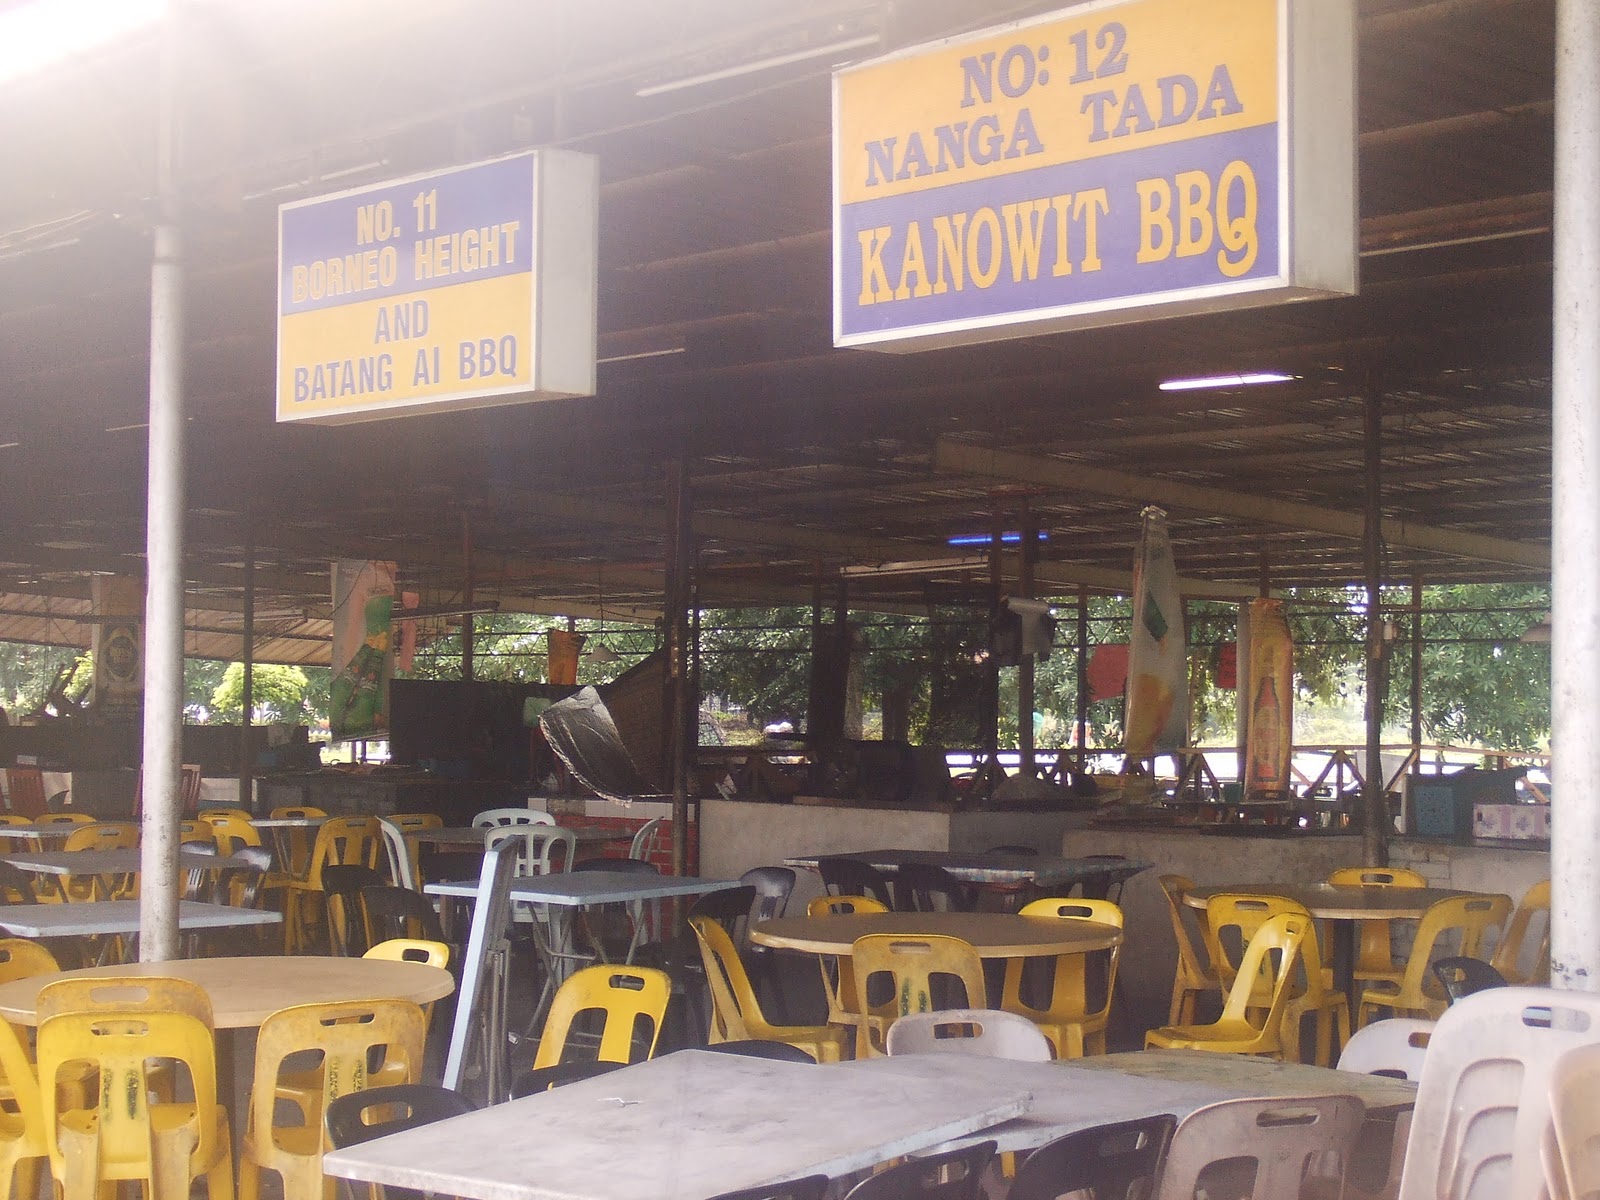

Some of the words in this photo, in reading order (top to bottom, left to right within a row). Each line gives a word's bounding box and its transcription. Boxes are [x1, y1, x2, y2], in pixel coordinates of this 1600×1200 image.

[960, 44, 1049, 108] NO:
[1069, 22, 1128, 86] 12
[865, 108, 1044, 187] NANGA
[1080, 64, 1243, 143] TADA
[356, 200, 400, 245] NO.
[413, 189, 438, 233] 11
[857, 188, 1109, 306] KANOWIT
[1136, 160, 1258, 278] BBQ
[292, 246, 397, 304] BORNEO
[415, 221, 520, 280] HEIGHT
[374, 300, 429, 344] AND
[294, 353, 393, 402] BATANG
[413, 346, 440, 386] AI
[459, 334, 517, 380] BBQ
